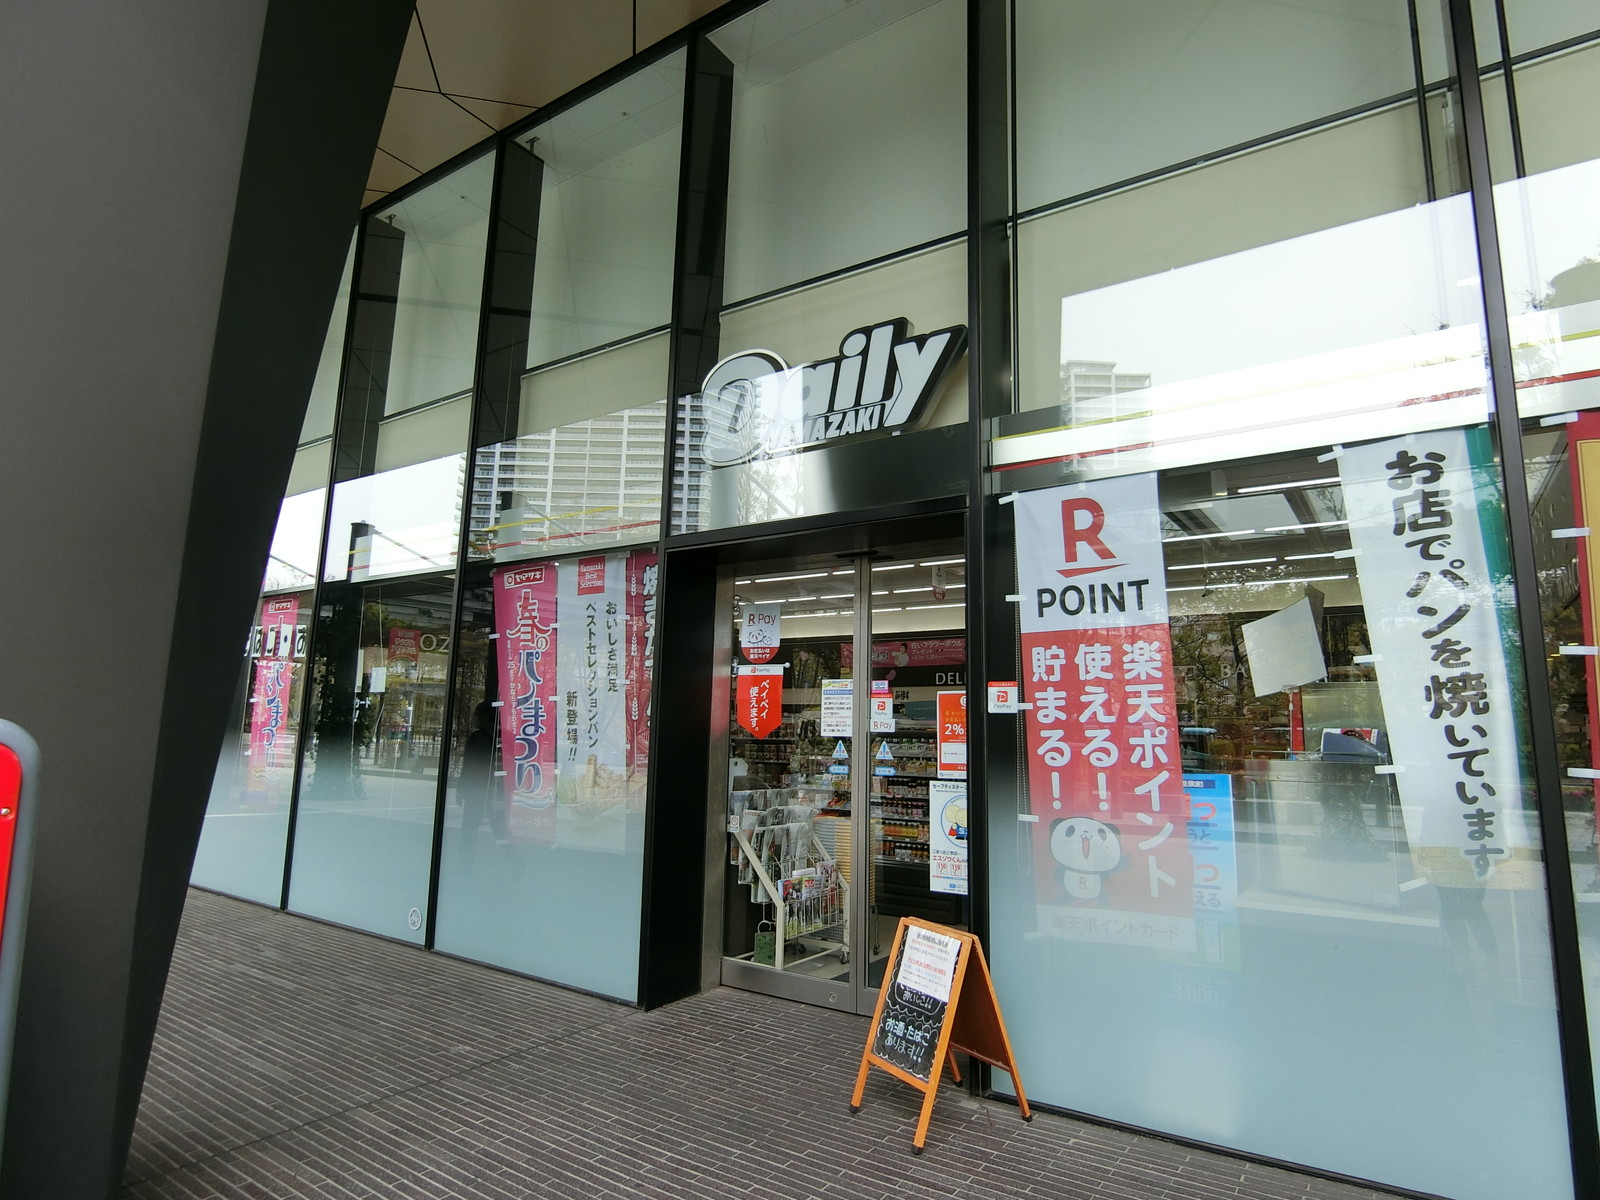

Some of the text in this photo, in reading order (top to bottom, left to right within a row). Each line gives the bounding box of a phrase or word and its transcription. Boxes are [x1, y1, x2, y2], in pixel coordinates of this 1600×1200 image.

[702, 323, 951, 463] Daily
[769, 404, 883, 447] AZAKI
[515, 571, 544, 584] ヤマザキ
[1036, 578, 1150, 618] POINT
[758, 613, 777, 626] Pay
[605, 601, 619, 693] おいしさ満足
[1384, 450, 1505, 878] お店でパンを焼いています
[506, 589, 552, 796] 春のパンまつり
[585, 602, 599, 749] ベストセレクションパン
[760, 679, 770, 719] ペイペイ
[880, 721, 892, 729] Pay
[944, 723, 966, 735] 2%
[1122, 640, 1176, 898] 楽天ポイント
[1051, 914, 1180, 941] 楽天ポイントカード
